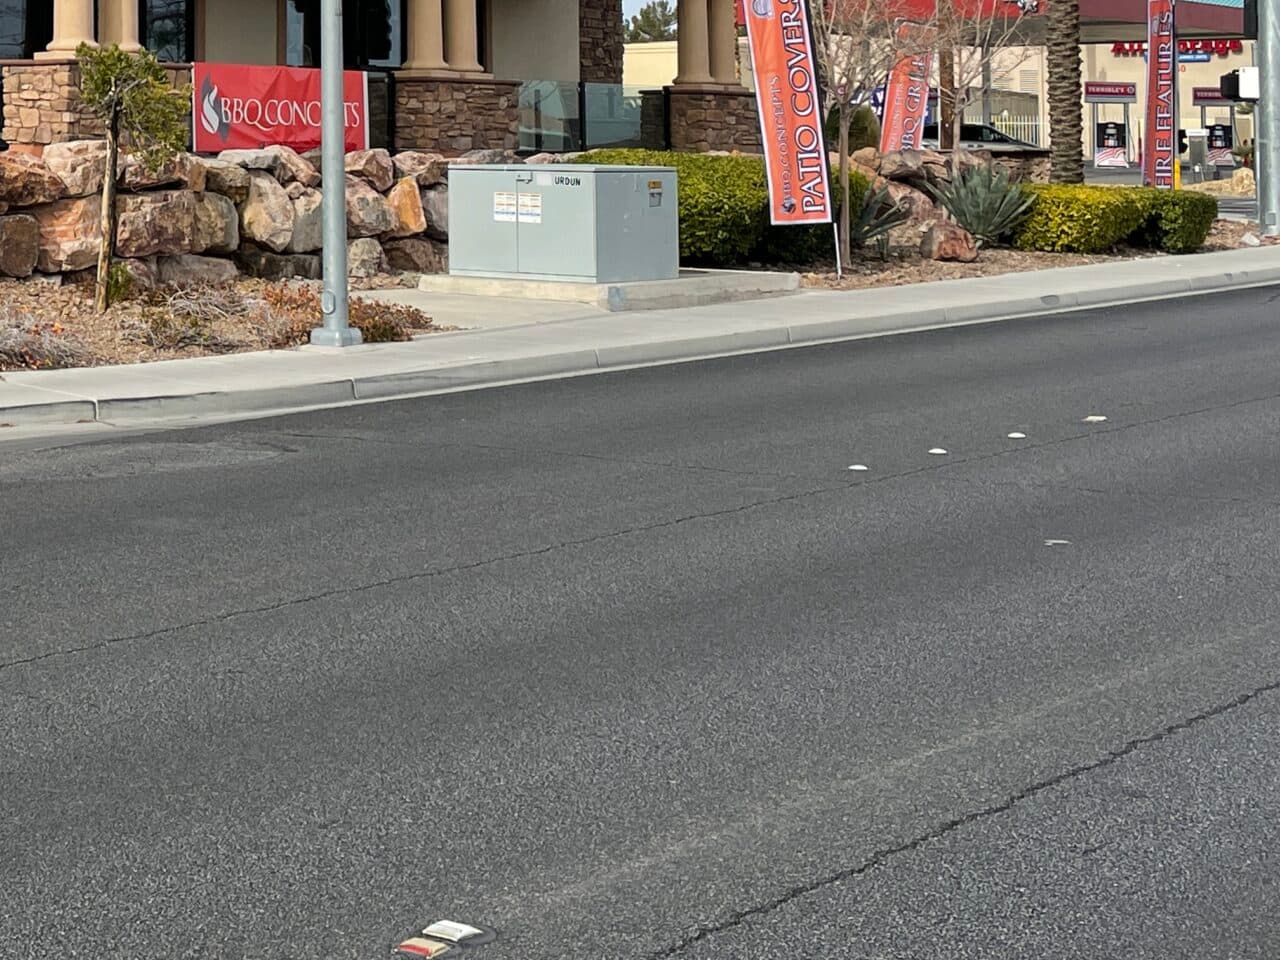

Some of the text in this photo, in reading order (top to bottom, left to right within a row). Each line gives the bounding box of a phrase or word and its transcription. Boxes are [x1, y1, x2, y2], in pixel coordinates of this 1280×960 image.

[220, 97, 360, 132] BBQ CONCTS
[768, 74, 789, 167] CONCEPTS
[1155, 12, 1173, 190] FIRE FEATURES
[794, 126, 825, 214] PATIO
